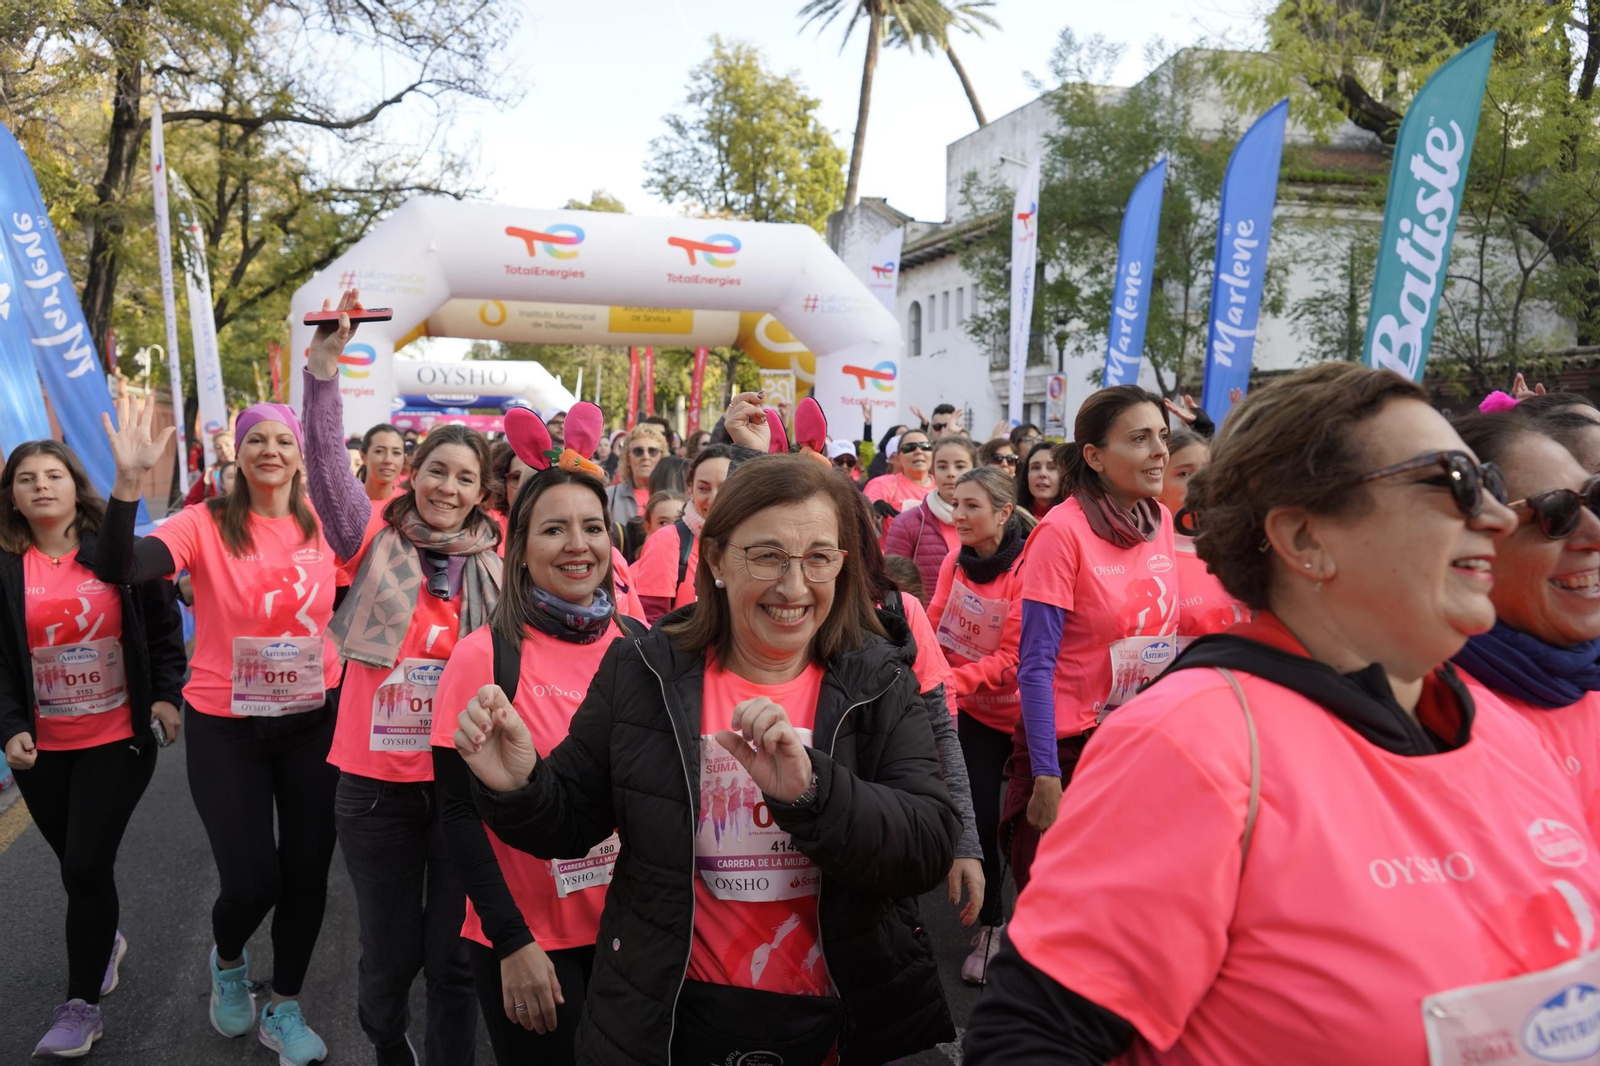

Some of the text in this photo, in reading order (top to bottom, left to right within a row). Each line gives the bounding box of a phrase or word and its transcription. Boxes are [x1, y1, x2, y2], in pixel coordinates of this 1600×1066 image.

[1371, 120, 1465, 381] Batiste
[504, 265, 585, 280] TotalEnergies
[667, 273, 742, 287] TotalEnergies
[1213, 219, 1259, 367] Marlene
[519, 309, 596, 321] Instituto Municipal
[544, 322, 583, 330] Deportes
[1107, 261, 1142, 387] Marlene
[417, 366, 507, 386] OYSHO
[1094, 565, 1126, 576] OYSHO
[959, 616, 981, 636] 016
[65, 671, 101, 687] 016
[264, 670, 298, 684] 016
[76, 688, 93, 696] 5153
[241, 703, 271, 712] OYSHO
[409, 697, 433, 713] 01
[382, 737, 417, 746] OYSHO
[705, 761, 739, 774] SUMA
[752, 801, 774, 829] 0
[598, 844, 615, 855] 180
[771, 840, 800, 853] 414
[559, 861, 586, 872] CARRERA
[586, 859, 594, 867] DE
[717, 857, 810, 869] CARRERA DE LA MUJER
[1369, 851, 1475, 889] OYSHO
[715, 877, 769, 891] OYSHO
[801, 876, 820, 887] Sant
